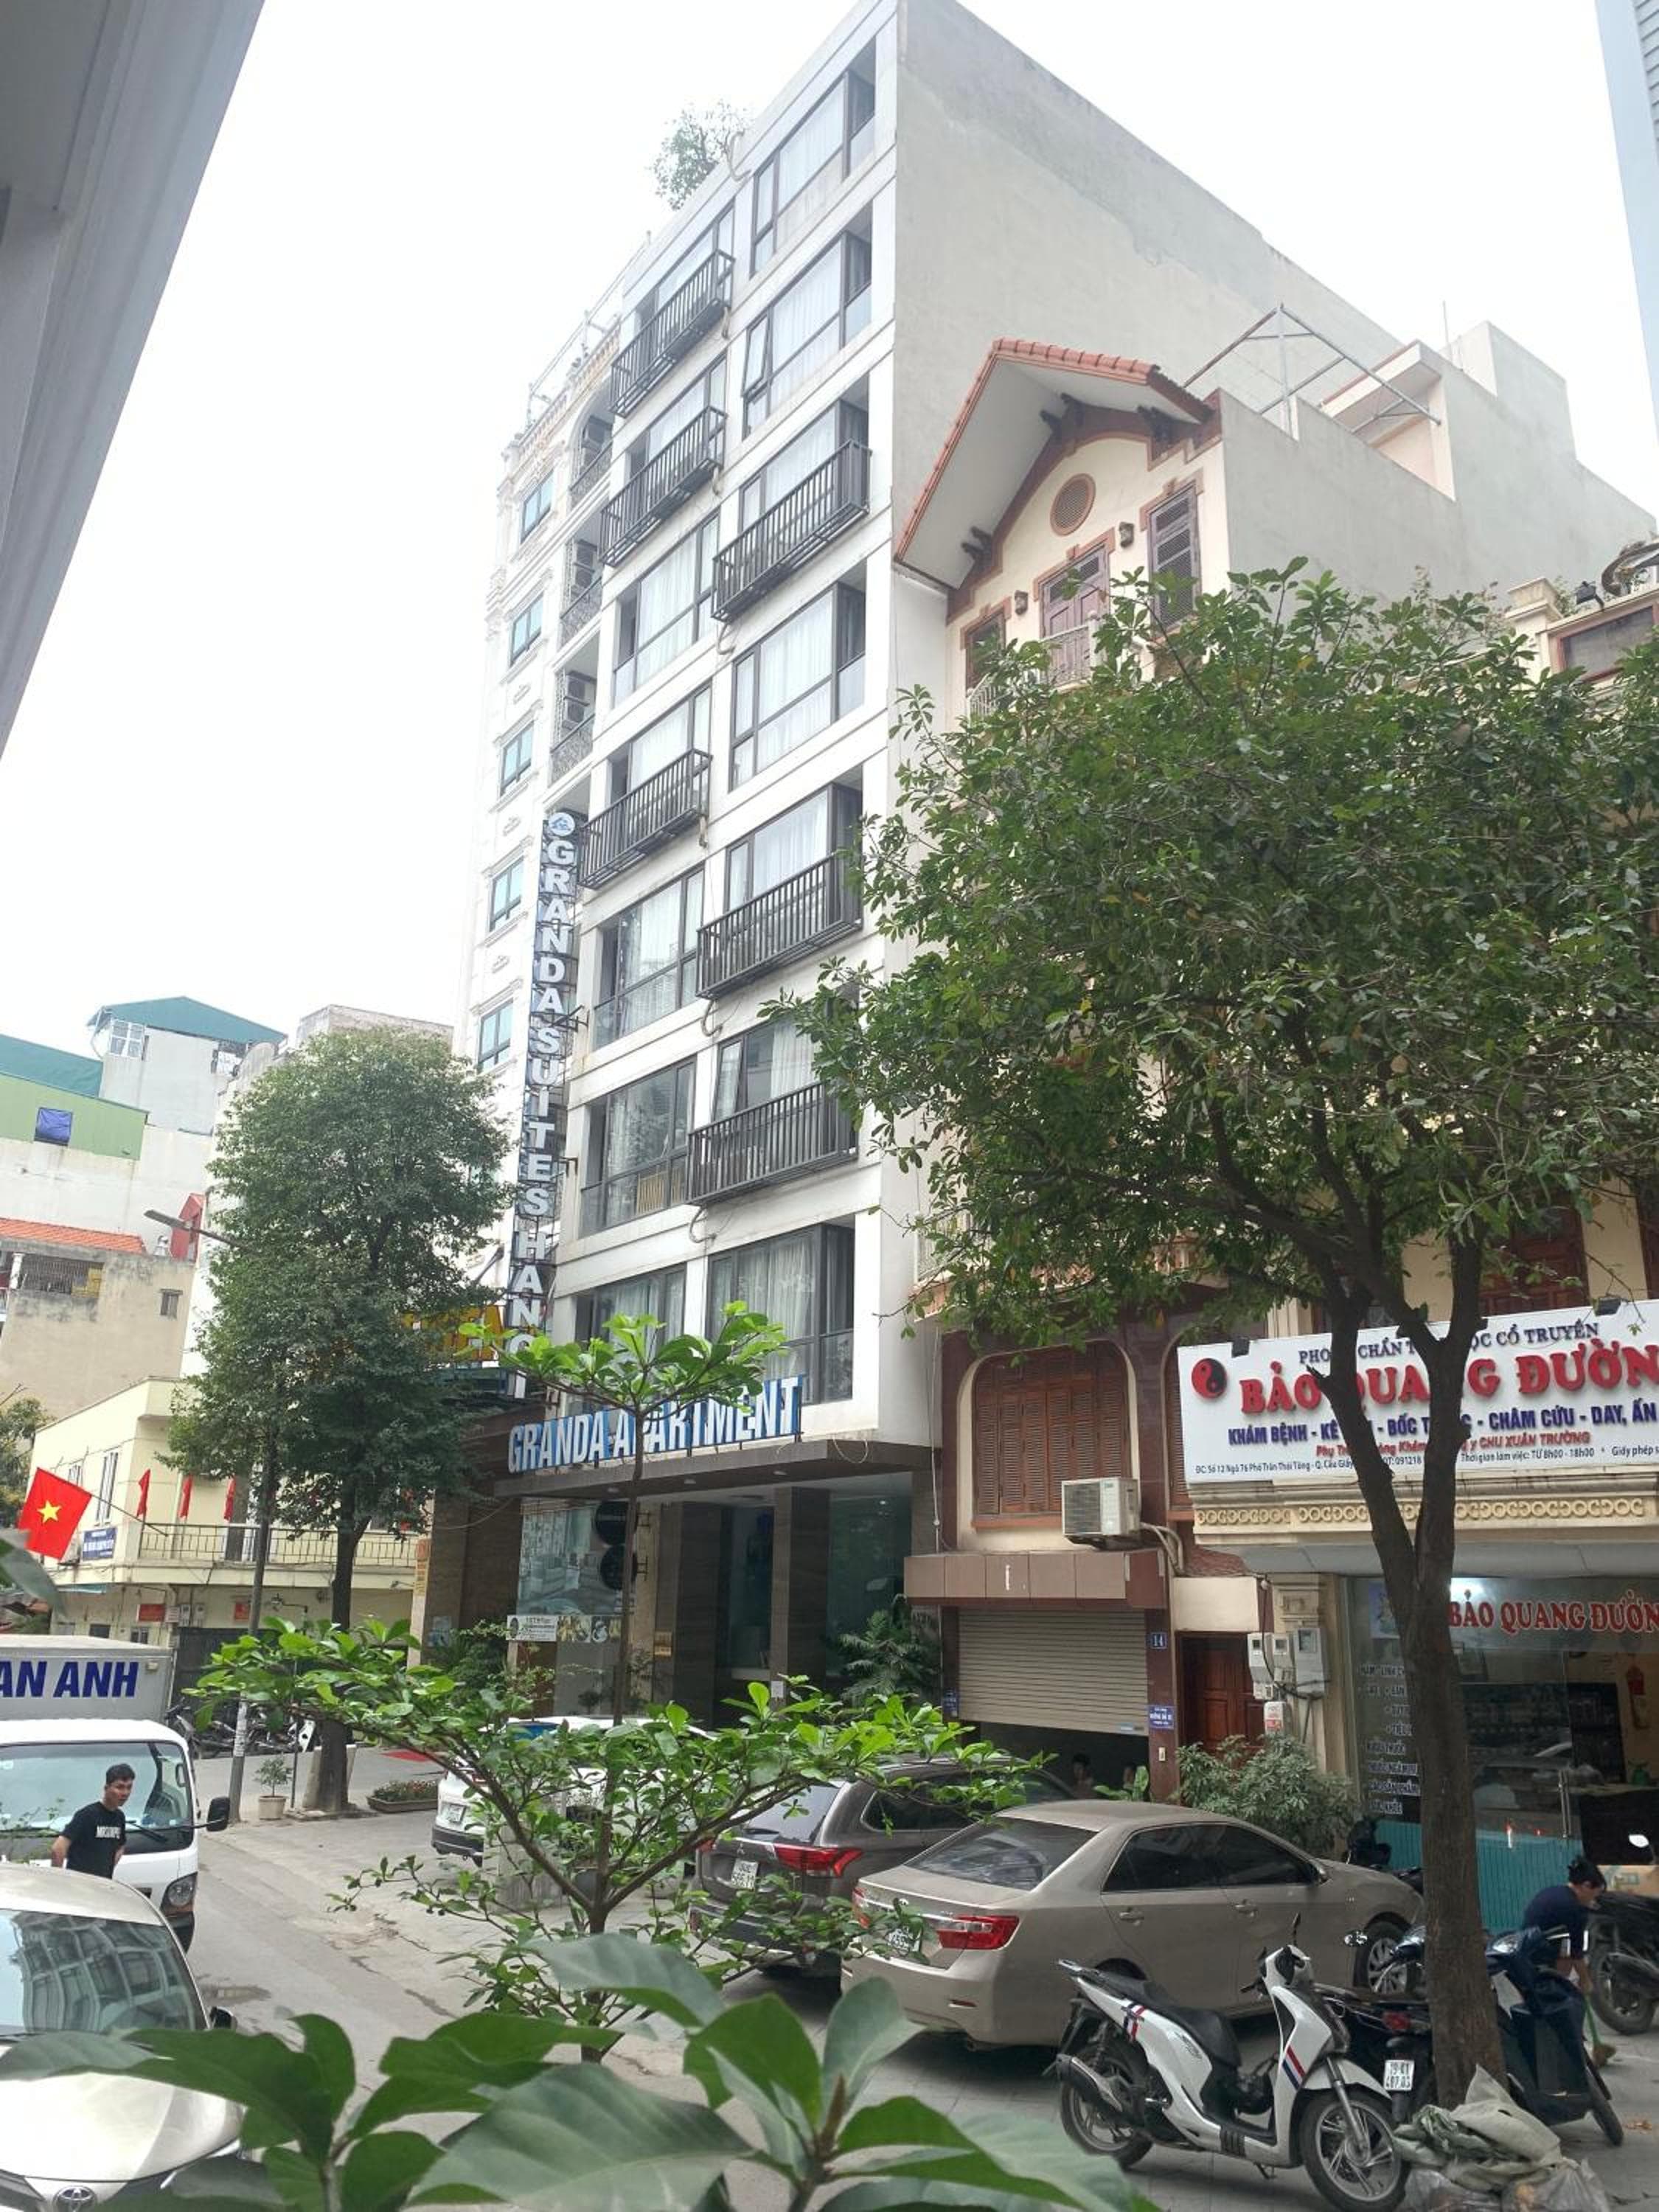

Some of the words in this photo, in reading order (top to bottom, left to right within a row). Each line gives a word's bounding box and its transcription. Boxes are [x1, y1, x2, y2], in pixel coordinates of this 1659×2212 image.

[536, 840, 575, 1013] GRANDA
[524, 1027, 560, 1216] SUITES
[1239, 1361, 1322, 1414] BẢO
[508, 1409, 605, 1474] GRANDA
[1228, 1424, 1267, 1446] KHÁM
[1271, 1422, 1308, 1446] BỆNH
[1388, 1413, 1417, 1436] BỐC
[1489, 1408, 1536, 1430] CHÂM
[1542, 1405, 1575, 1427] CỨU
[1500, 1600, 1586, 1635] QUANG
[53, 1660, 139, 1698] ANH
